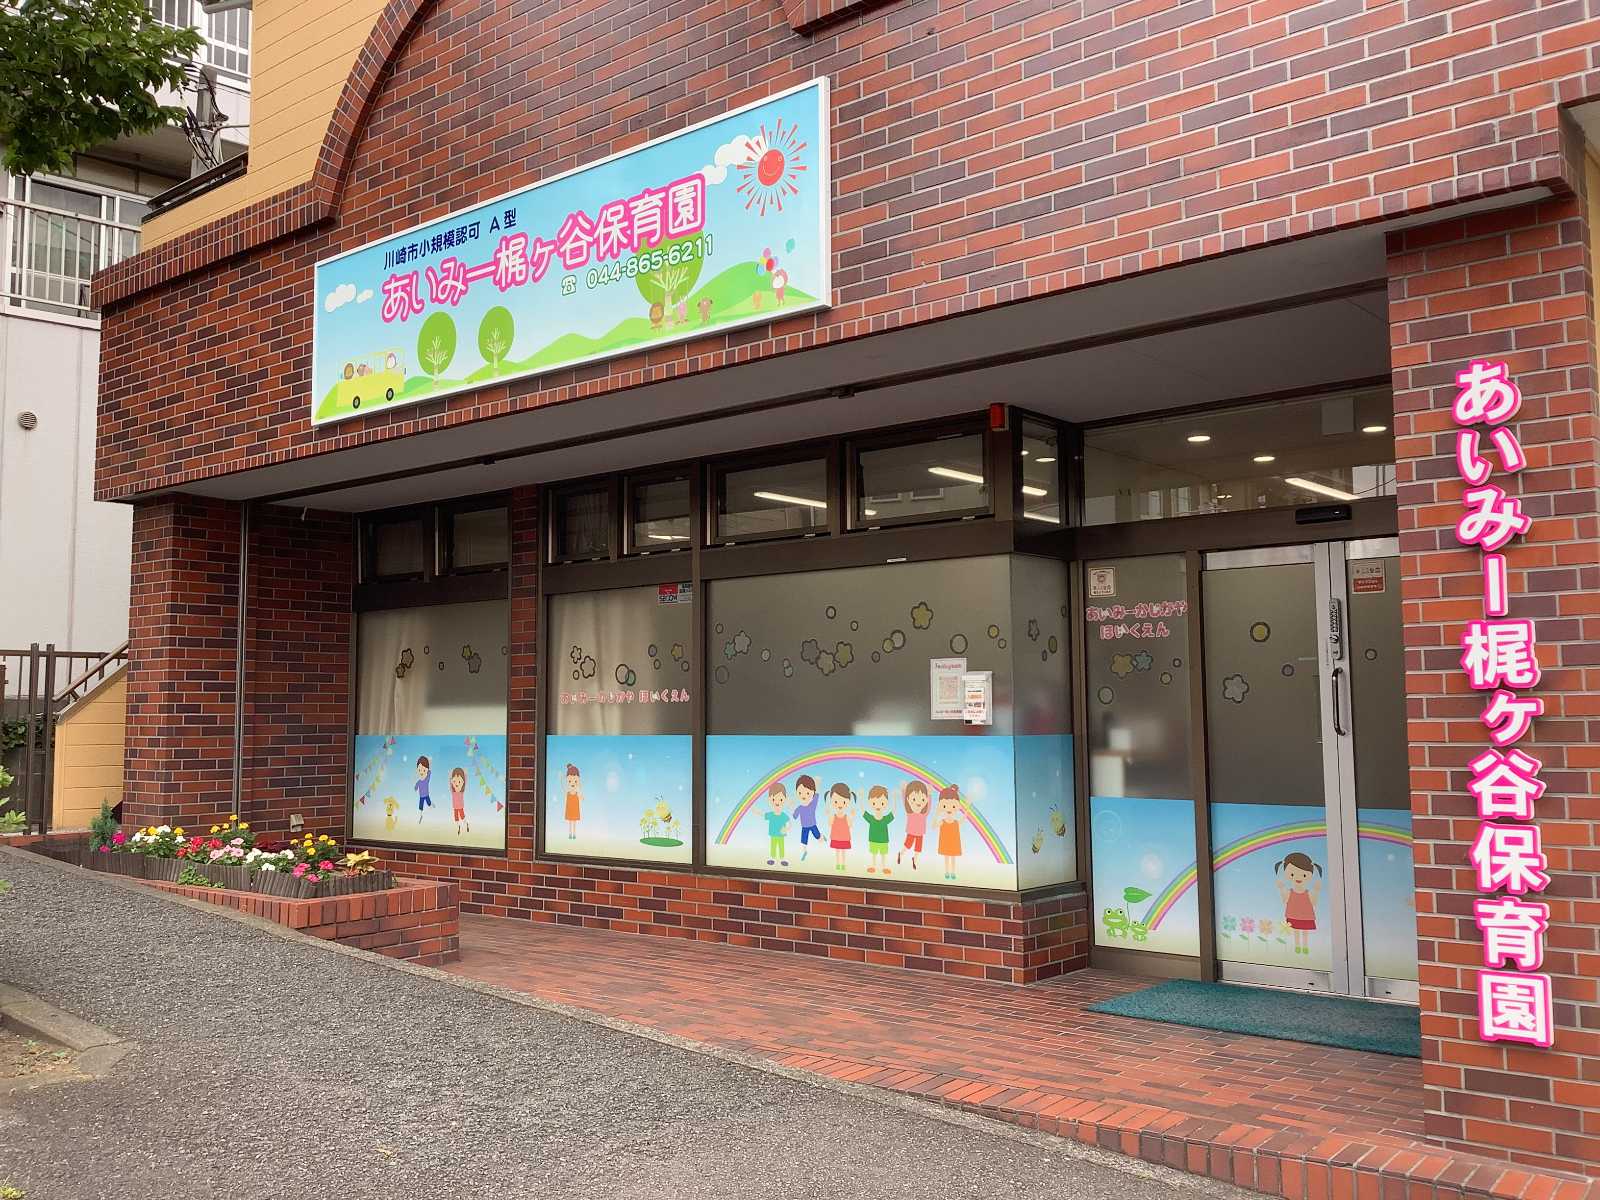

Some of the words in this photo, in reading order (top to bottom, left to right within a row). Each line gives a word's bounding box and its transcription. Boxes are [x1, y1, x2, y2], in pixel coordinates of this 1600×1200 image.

[384, 221, 480, 270] 川崎市小規模認可
[586, 233, 714, 290] 044-865-6211
[1086, 600, 1188, 622] あいみーかじがや
[1099, 621, 1170, 640] ほいくえん
